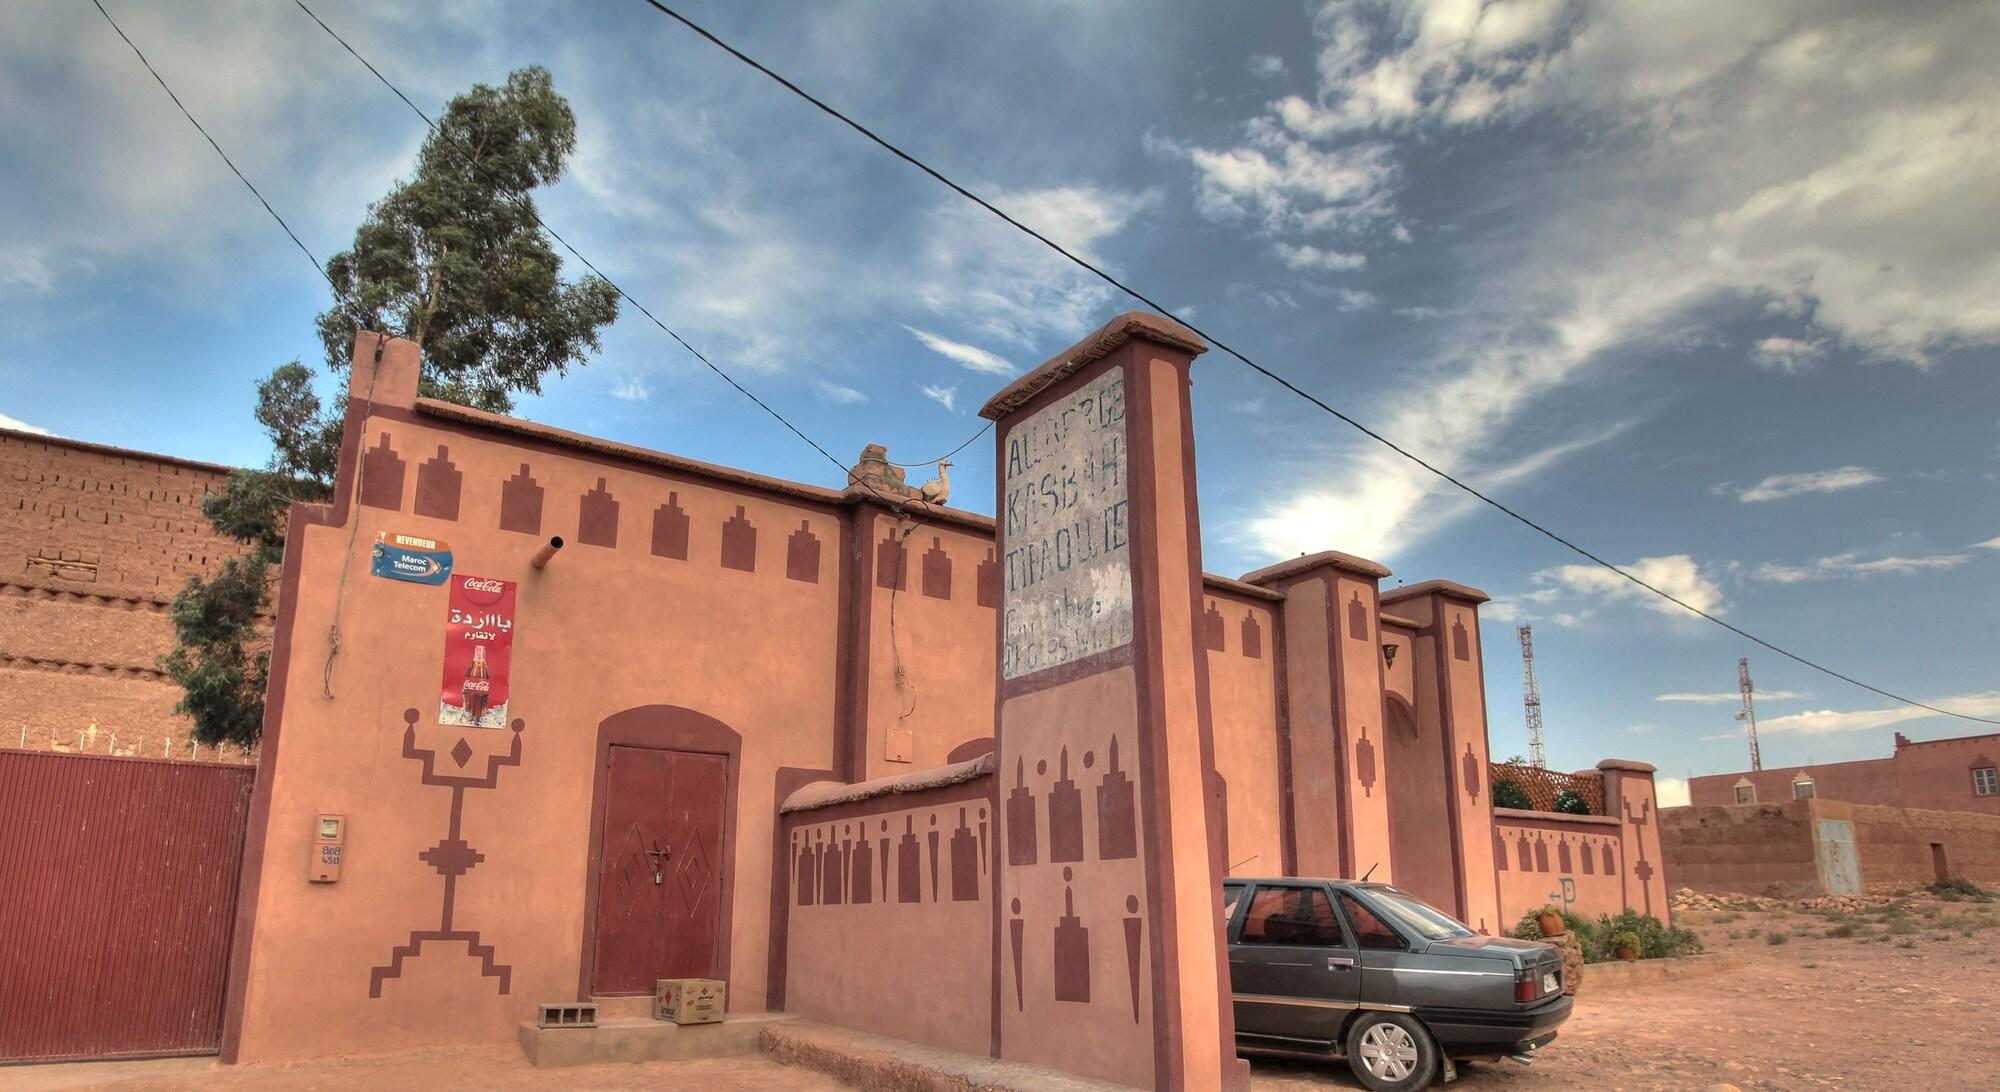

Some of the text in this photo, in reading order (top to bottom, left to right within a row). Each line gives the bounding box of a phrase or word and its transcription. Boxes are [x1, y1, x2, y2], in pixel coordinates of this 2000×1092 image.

[396, 535, 435, 549] REVENDEUR
[393, 560, 426, 572] Telecom
[402, 554, 427, 566] Maroc
[464, 577, 504, 593] Coca-Cola
